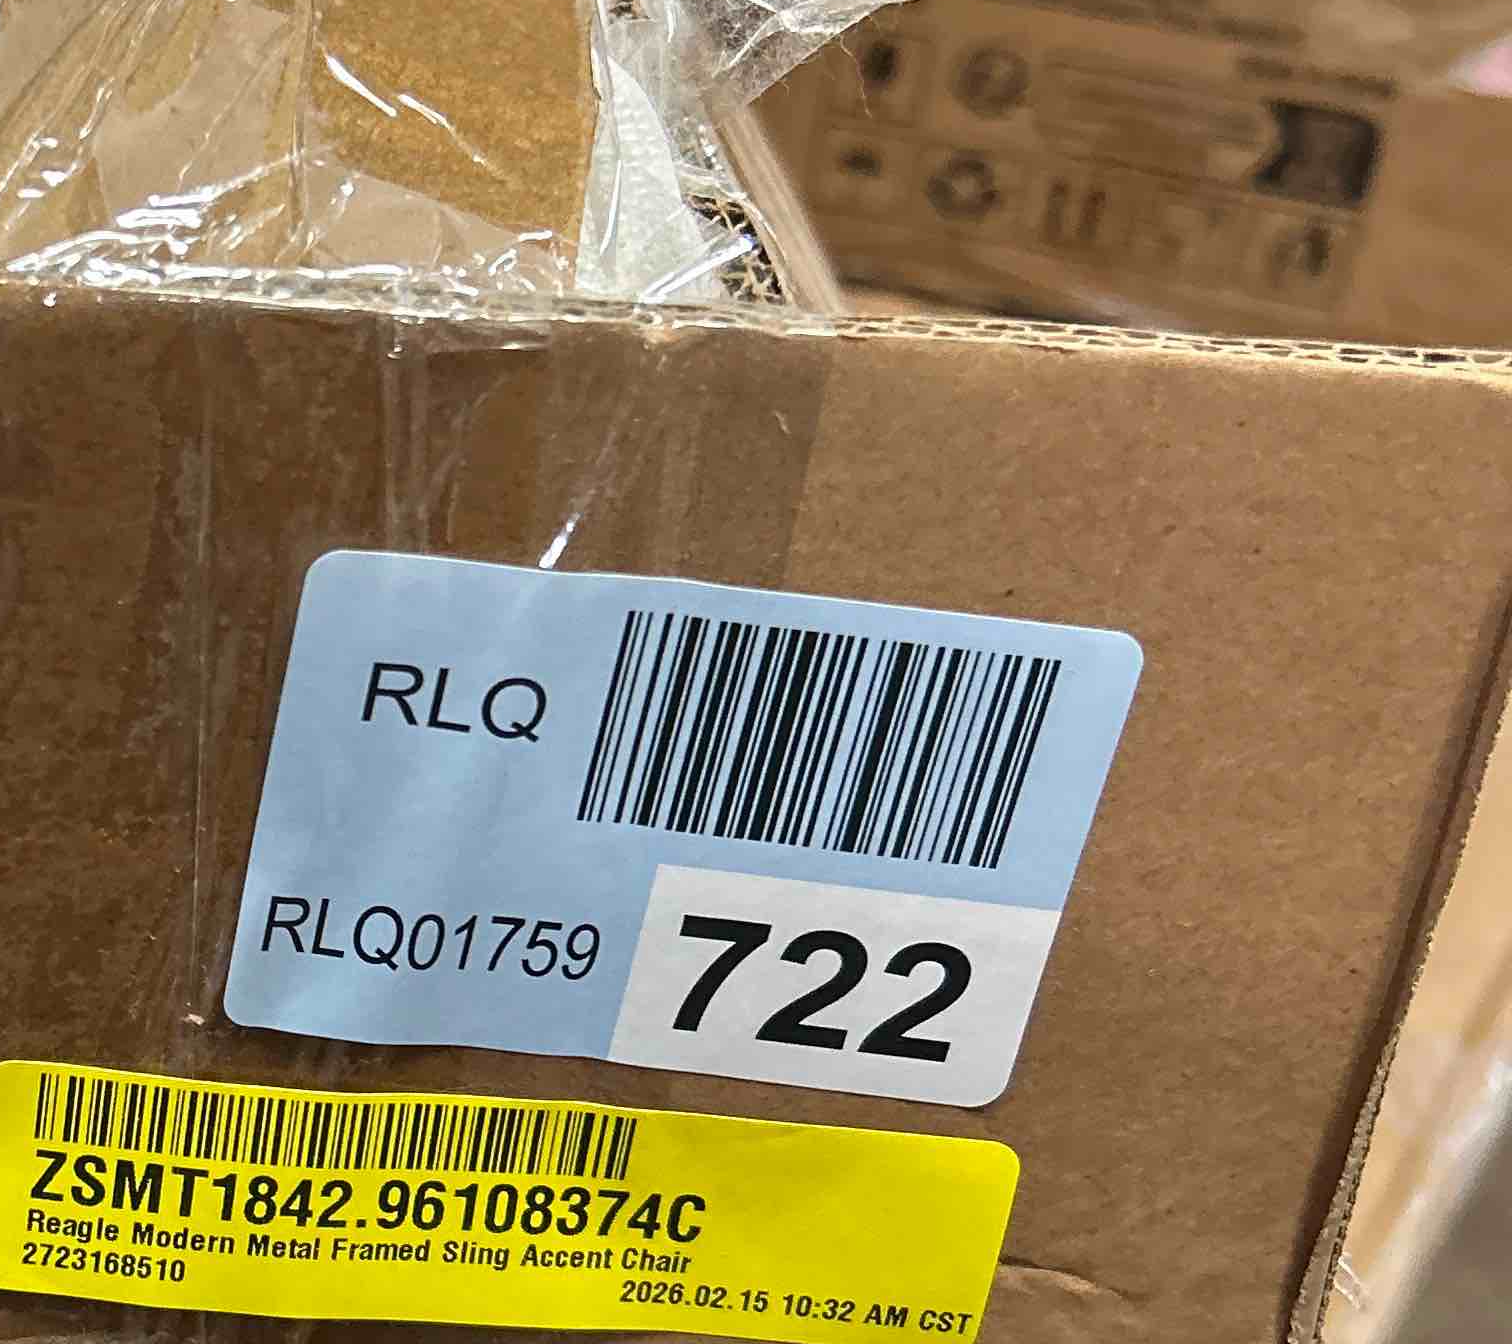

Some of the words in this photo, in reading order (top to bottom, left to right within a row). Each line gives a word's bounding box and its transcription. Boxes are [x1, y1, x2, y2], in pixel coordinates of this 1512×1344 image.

[361, 662, 549, 743] RLQ
[261, 895, 601, 980] RLQ01759
[672, 913, 973, 1063] 722
[29, 1148, 707, 1243] ZSMT1842.96108374C
[22, 1242, 187, 1282] 2723168510
[26, 1208, 120, 1243] Reagle
[132, 1222, 236, 1255] Modern
[247, 1234, 321, 1261] Metal
[331, 1237, 431, 1262] Framed
[441, 1240, 510, 1271] Sling
[520, 1244, 613, 1270] Accent
[621, 1247, 693, 1274] Chair
[619, 1279, 770, 1313] 2026.02.15
[782, 1293, 854, 1323] 10:32
[863, 1303, 909, 1329] AM
[918, 1310, 973, 1335] CST
